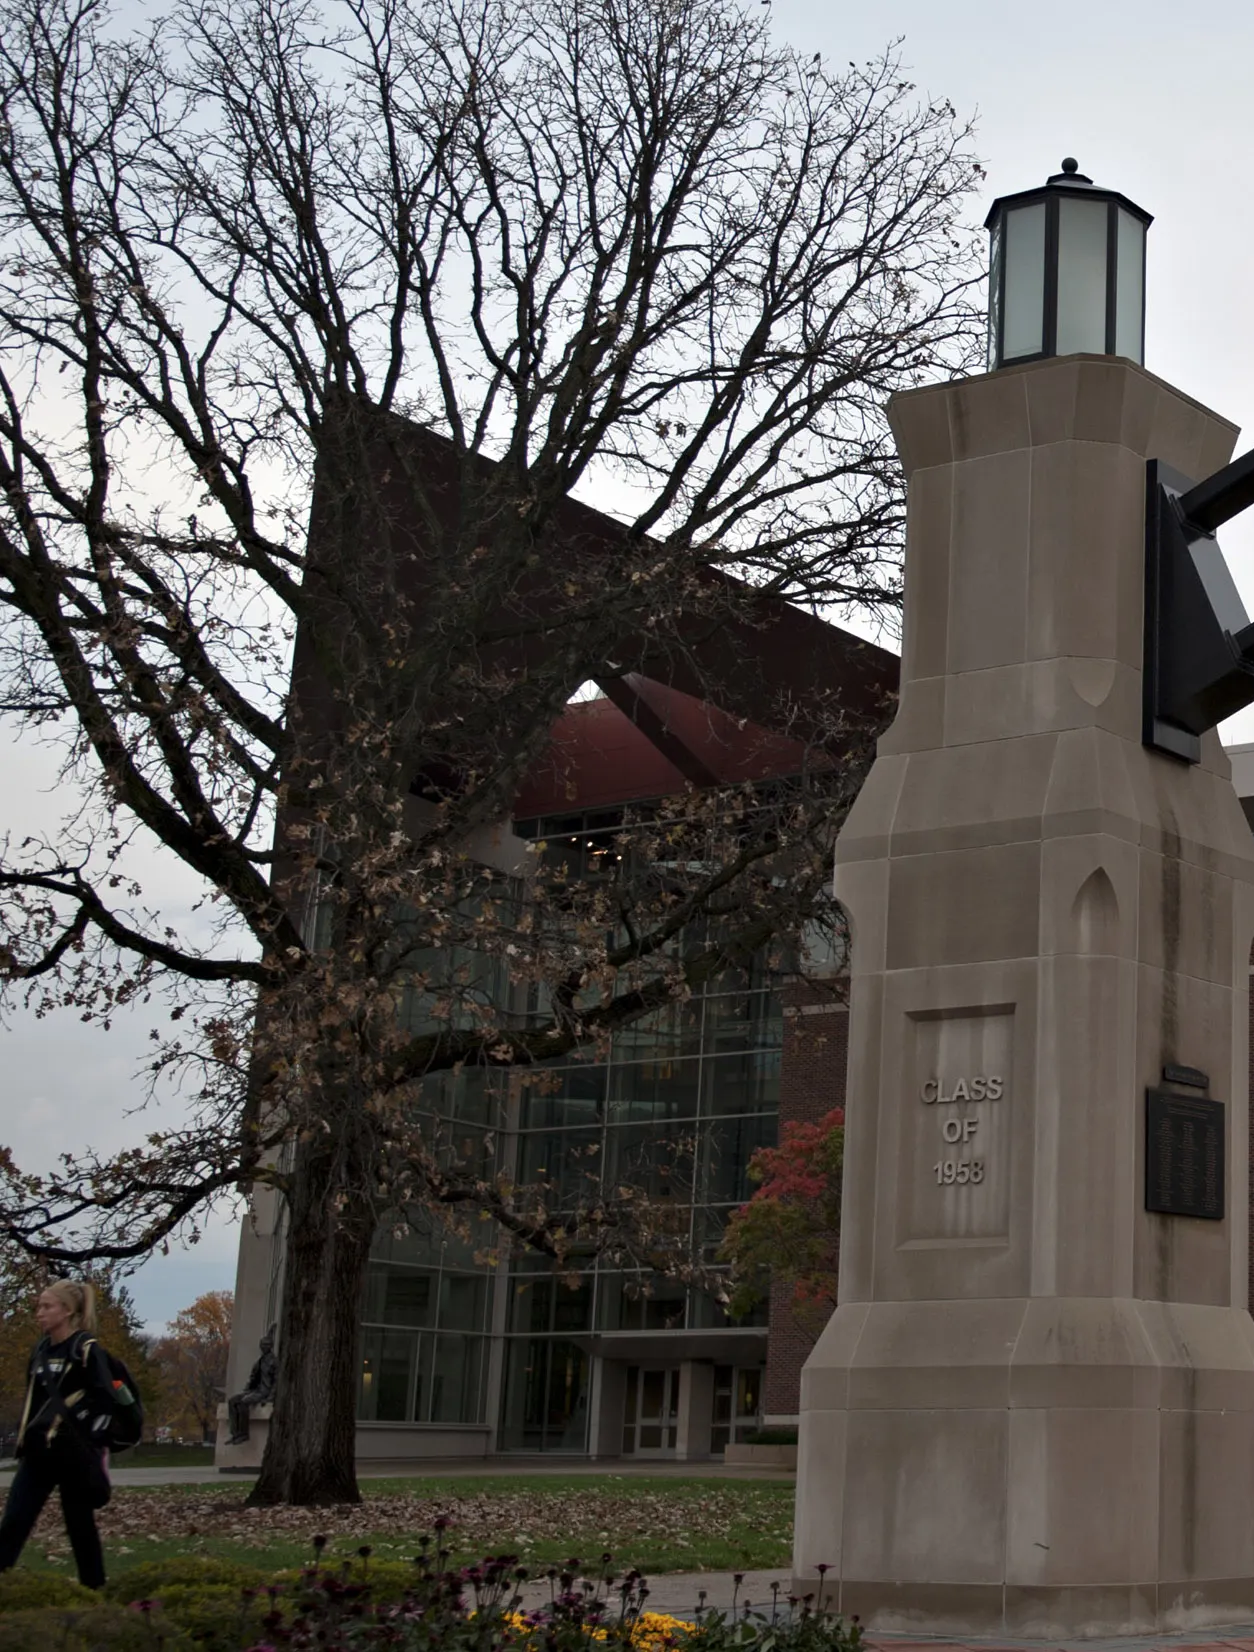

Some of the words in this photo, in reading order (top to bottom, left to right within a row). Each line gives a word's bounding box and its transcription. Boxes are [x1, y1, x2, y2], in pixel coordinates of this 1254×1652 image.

[921, 1076, 1003, 1104] CLASS
[943, 1117, 979, 1143] OF
[933, 1159, 984, 1185] 1958
